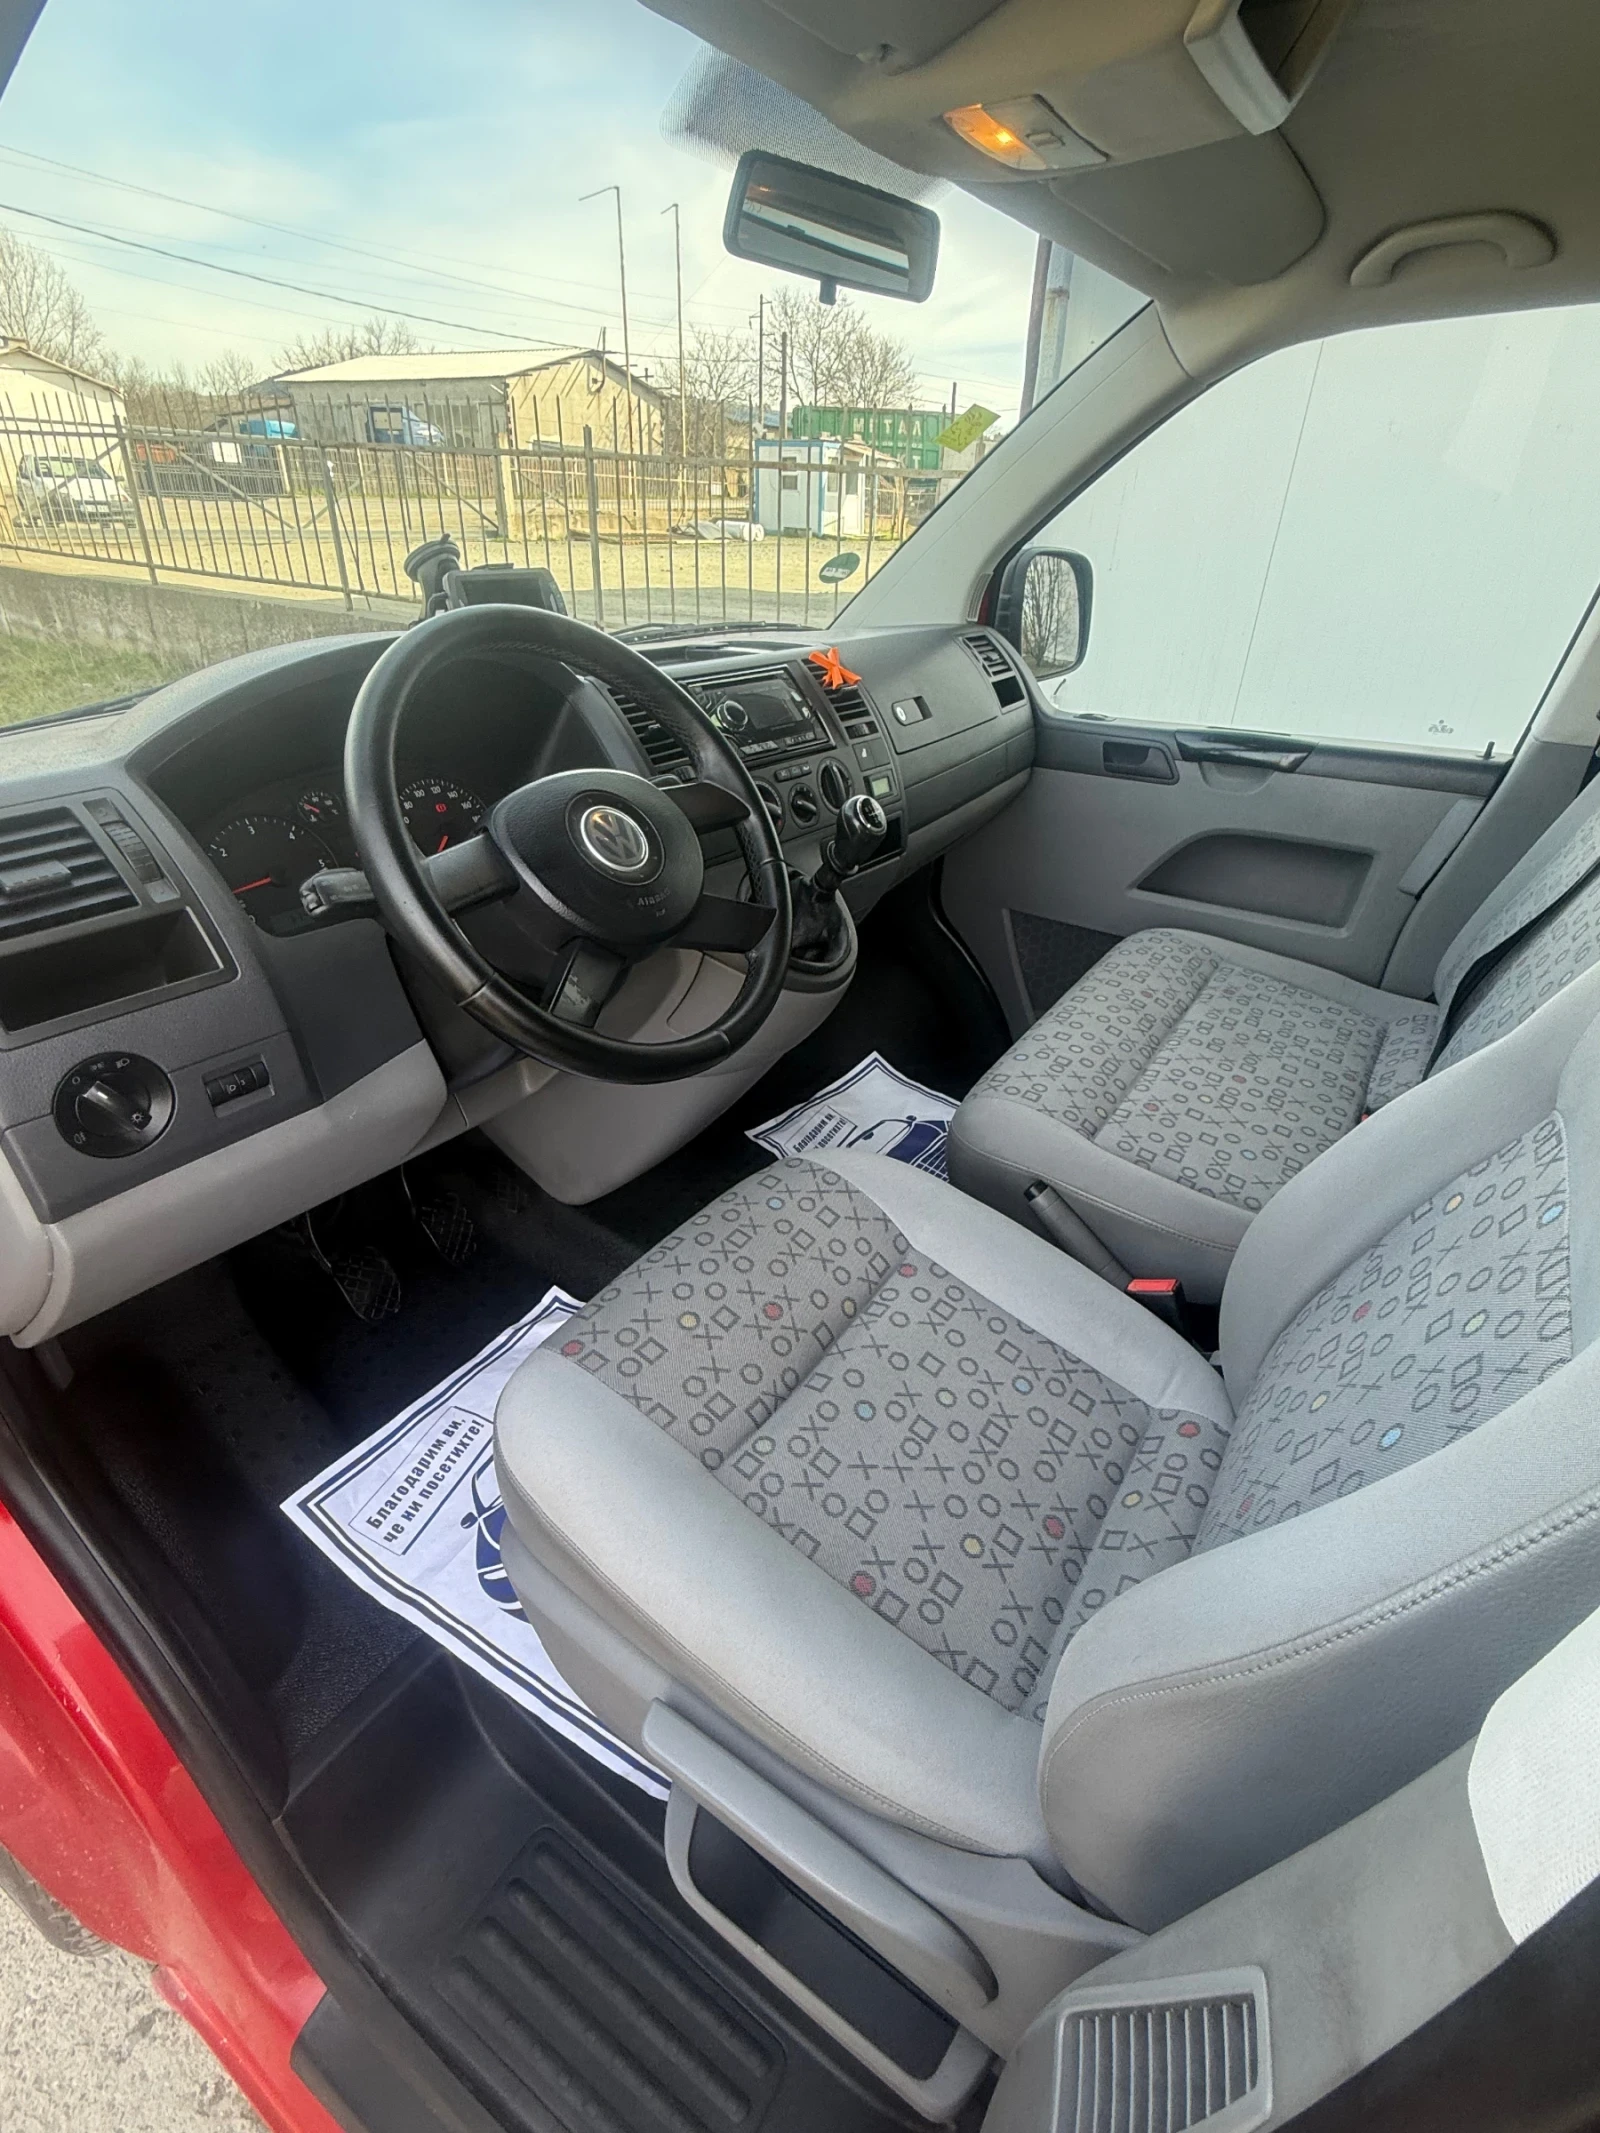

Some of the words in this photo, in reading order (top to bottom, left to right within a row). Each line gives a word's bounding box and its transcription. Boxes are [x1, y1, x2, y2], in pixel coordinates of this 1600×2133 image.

[403, 801, 413, 810] 80
[247, 826, 255, 835] 3
[289, 832, 296, 840] 4
[220, 848, 228, 857] 2
[318, 859, 326, 867] 5
[365, 1438, 447, 1529] Благодарим
[442, 1418, 466, 1438] ви,
[382, 1523, 405, 1543] че
[400, 1500, 424, 1522] ни
[418, 1419, 485, 1500] посетихте!
